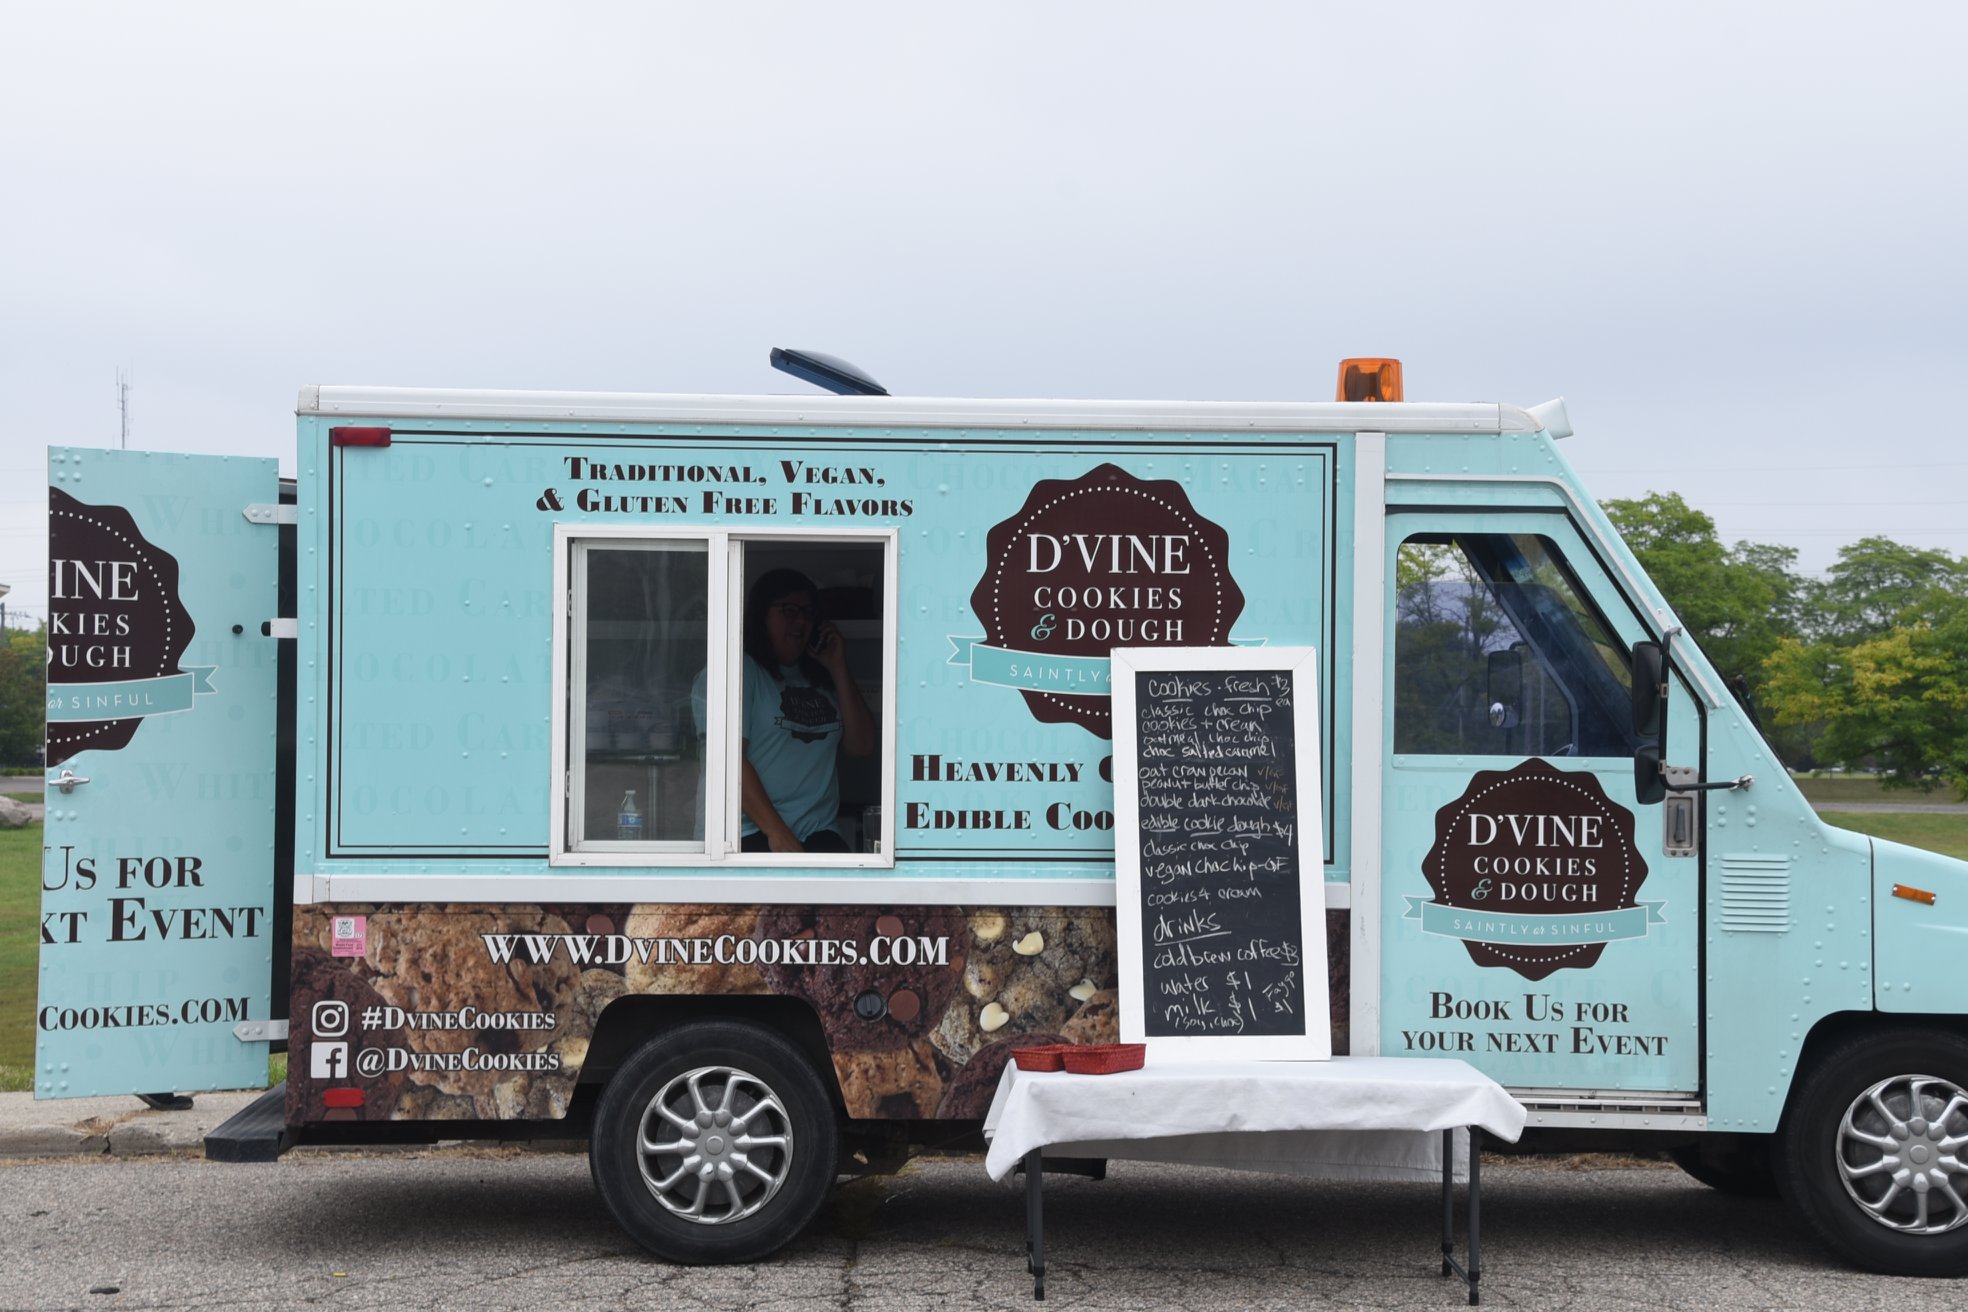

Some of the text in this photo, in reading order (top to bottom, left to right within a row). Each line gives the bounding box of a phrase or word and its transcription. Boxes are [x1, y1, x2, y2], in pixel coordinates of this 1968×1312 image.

[564, 456, 767, 486] TRADITIONAL,
[779, 460, 886, 488] VEGAN,
[536, 487, 913, 517] & GLUTEN FREE FLAVORS
[1026, 533, 1191, 575] D'VINE
[1034, 586, 1183, 610] COOKIES
[51, 612, 130, 637] KIES
[1030, 613, 1184, 642] & DOUGH
[48, 644, 132, 668] UGH
[1009, 663, 1101, 683] SAINTLY
[71, 692, 154, 710] SINFUL
[1142, 704, 1195, 719] classic
[1142, 716, 1197, 733] cookies
[910, 754, 1085, 783] HEAVENLY
[1139, 763, 1168, 779] oat
[1142, 778, 1192, 795] peanut
[1140, 791, 1184, 809] double
[904, 802, 1032, 830] EDIBLE
[1141, 816, 1181, 830] edible
[1467, 813, 1603, 848] D'VINE
[115, 856, 205, 889] FOR
[1473, 855, 1597, 876] COOKIES
[1147, 890, 1197, 906] cookies
[1470, 878, 1598, 902] & DOUGH
[106, 897, 264, 942] EVENT
[1154, 908, 1221, 942] drinks
[1453, 918, 1529, 936] SAINTLY
[1551, 921, 1616, 936] SINFUL
[1161, 973, 1209, 996] water
[1164, 993, 1215, 1022] milk
[1429, 991, 1630, 1023] BOOK US FOR
[1402, 1026, 1669, 1056] YOUR NEXT EVENT
